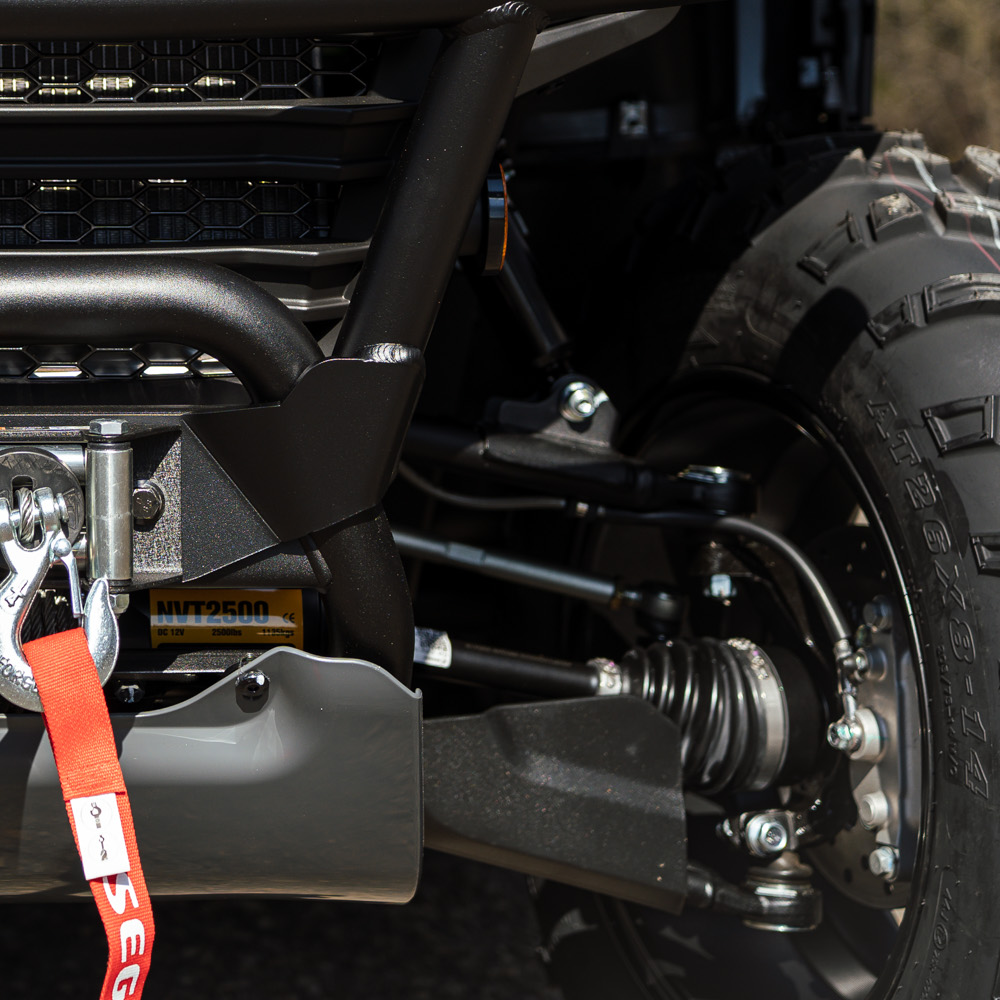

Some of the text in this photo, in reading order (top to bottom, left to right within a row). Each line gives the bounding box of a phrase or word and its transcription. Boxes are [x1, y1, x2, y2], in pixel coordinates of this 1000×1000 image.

[157, 600, 269, 624] NVT2500
[157, 628, 168, 636] DC
[170, 628, 185, 636] 12V
[211, 628, 242, 636] 2500lbs
